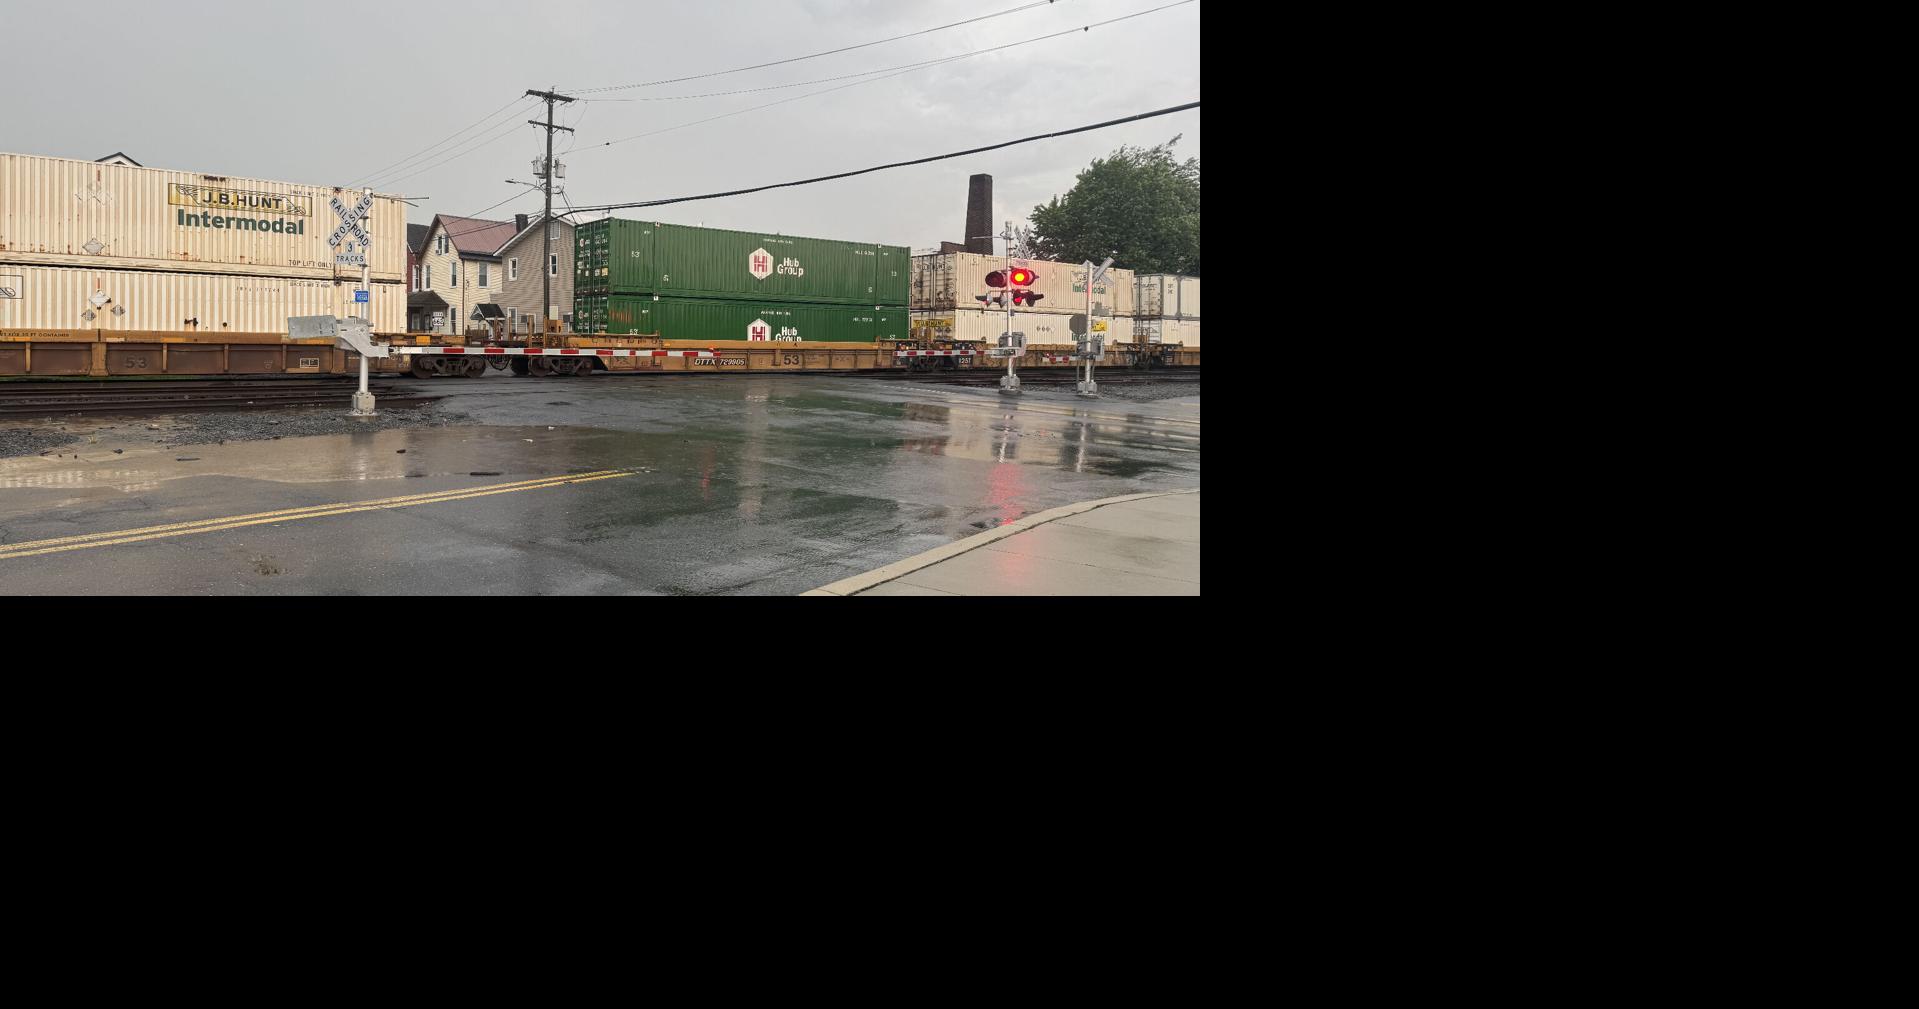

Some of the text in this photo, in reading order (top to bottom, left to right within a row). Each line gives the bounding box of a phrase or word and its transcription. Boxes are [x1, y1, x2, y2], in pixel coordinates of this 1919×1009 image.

[178, 209, 304, 235] Intermodal
[329, 197, 370, 246] CROSSING
[347, 242, 353, 252] 3
[783, 257, 799, 267] Hub
[777, 264, 804, 277] Group
[781, 326, 798, 336] Hub
[126, 356, 148, 369] 53
[783, 354, 800, 365] 53
